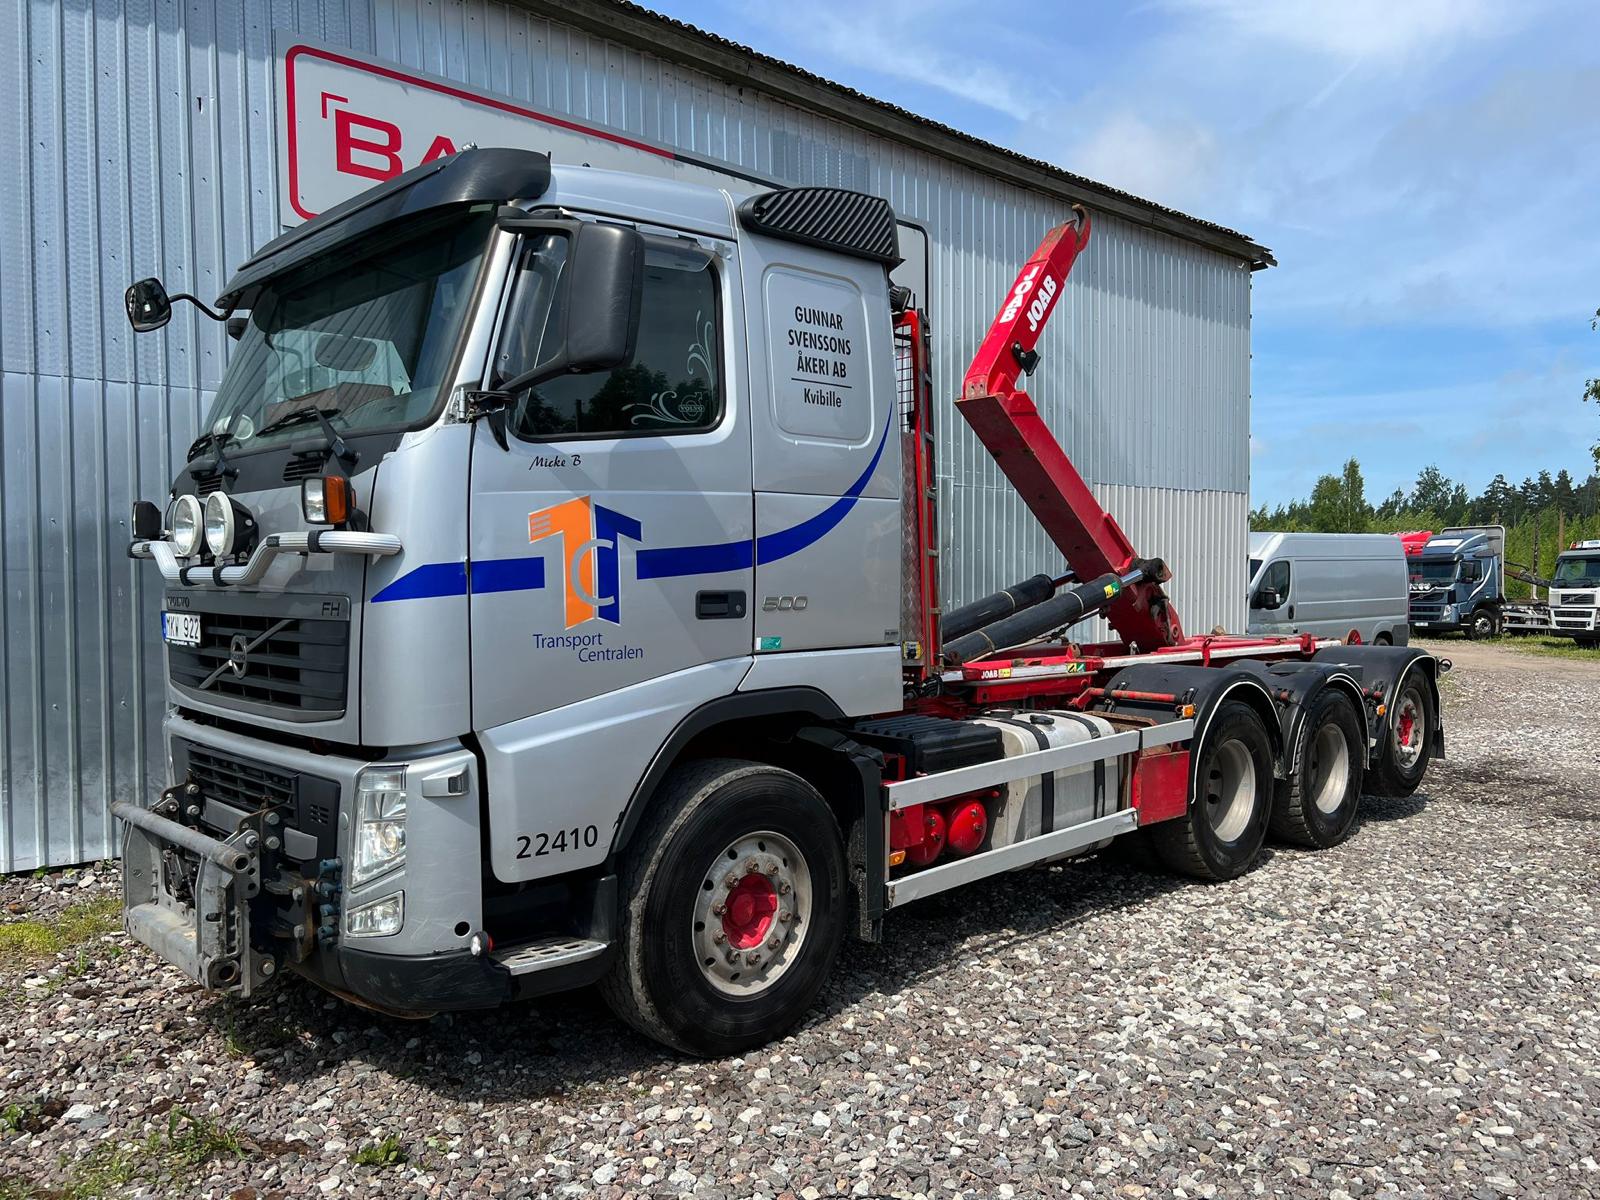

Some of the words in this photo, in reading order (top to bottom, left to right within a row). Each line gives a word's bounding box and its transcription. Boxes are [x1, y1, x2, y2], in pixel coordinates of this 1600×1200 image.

[999, 265, 1040, 324] JOAB
[1026, 274, 1057, 332] JOAB
[794, 305, 844, 331] GUNNAR
[788, 329, 852, 356] SVENSSONS
[796, 350, 830, 376] ÅKERI
[832, 361, 848, 379] AB
[803, 387, 842, 408] Kvibille
[528, 455, 566, 471] Micke
[570, 454, 582, 467] B
[321, 601, 341, 617] FH
[762, 595, 808, 611] 500
[183, 616, 199, 640] 922
[533, 632, 603, 650] Transport
[578, 645, 644, 662] Centralen
[981, 669, 998, 680] JOAB
[516, 824, 599, 860] 22410
